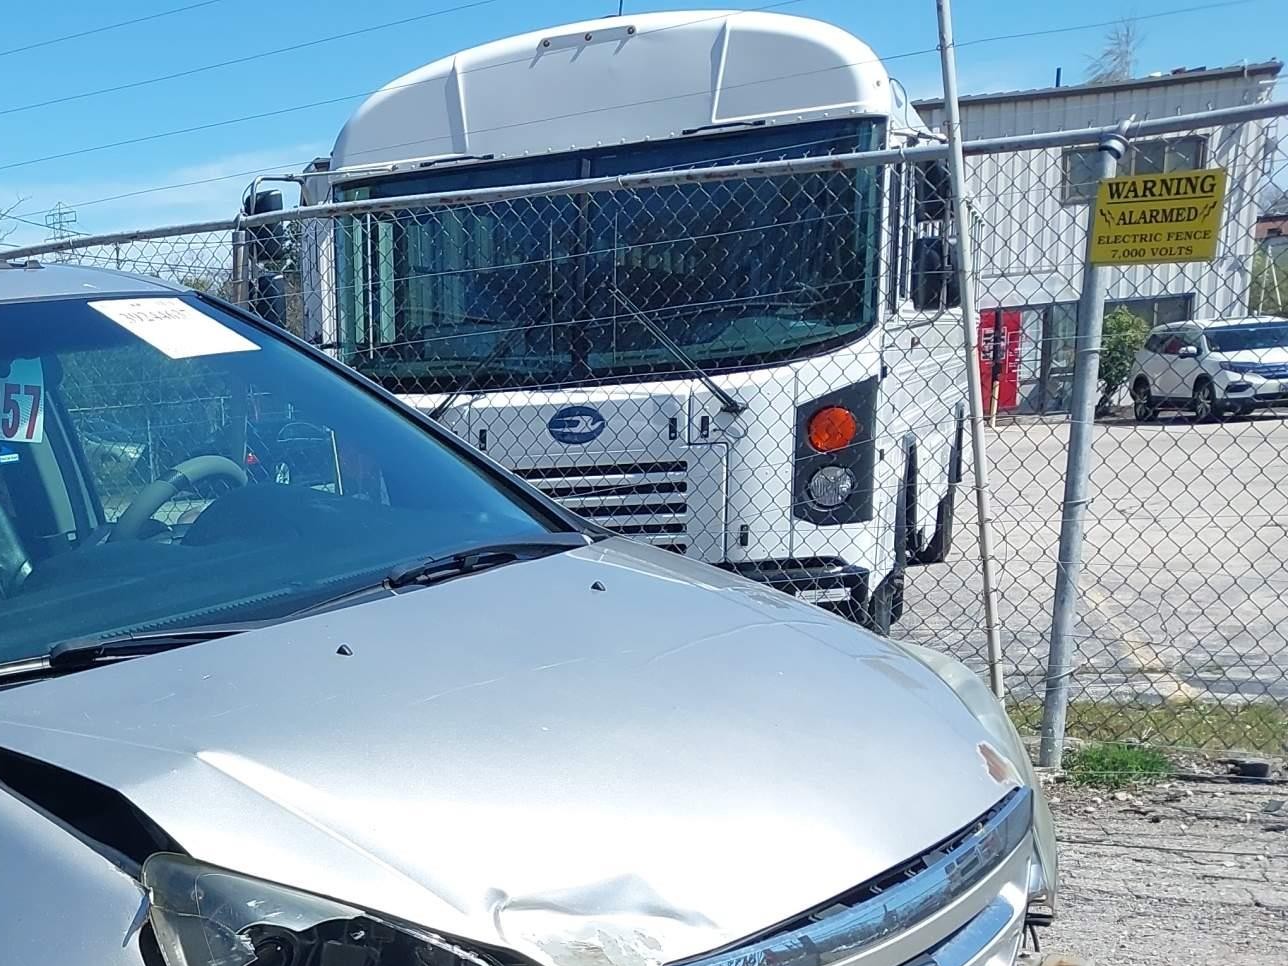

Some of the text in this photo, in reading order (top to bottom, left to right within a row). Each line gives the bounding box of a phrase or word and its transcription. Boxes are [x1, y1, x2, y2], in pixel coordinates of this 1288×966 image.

[1107, 174, 1216, 201] WARNING
[1115, 206, 1199, 226] ALARMED
[1097, 229, 1212, 245] ELECTRIC FENCE
[1110, 245, 1193, 259] 7,000 VOLTS
